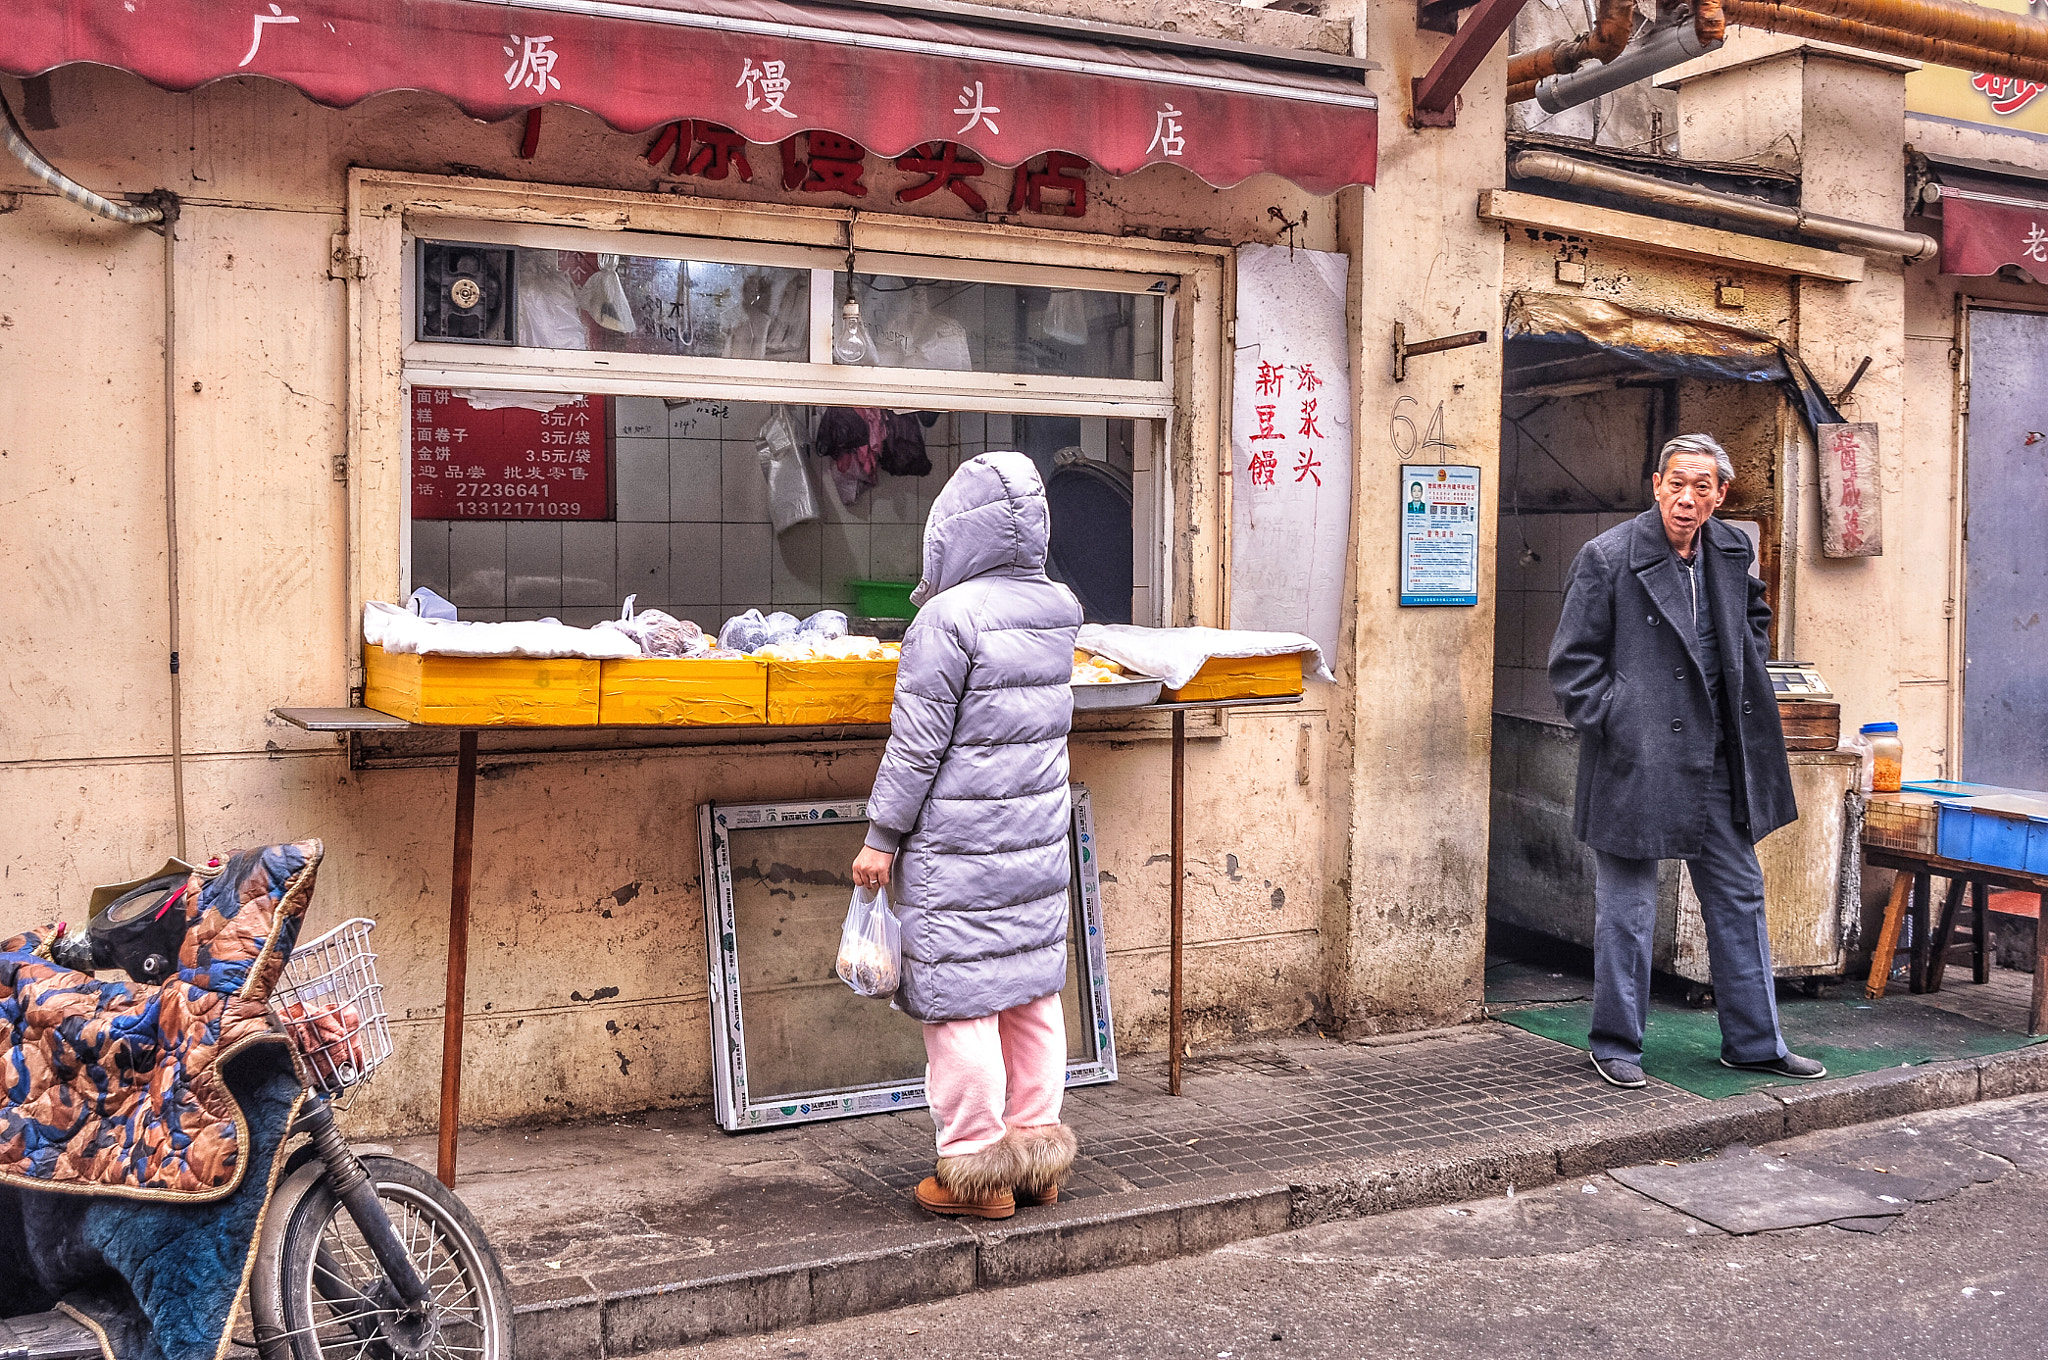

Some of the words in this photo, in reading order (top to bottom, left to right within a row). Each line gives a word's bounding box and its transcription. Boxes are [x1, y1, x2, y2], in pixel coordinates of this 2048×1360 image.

[240, 3, 1186, 156] 广源馒头店
[412, 389, 450, 405] 面饼
[412, 408, 433, 423] 糕
[540, 412, 590, 427] 3元/个
[1249, 397, 1324, 443] 豆浆
[412, 427, 469, 443] 面卷子
[541, 430, 591, 446] 3元/袋
[1389, 395, 1457, 464] 64
[412, 446, 451, 461] 金饼
[526, 449, 591, 464] 3.5元/袋
[504, 466, 589, 480] 批发零售
[1247, 447, 1322, 490] 馒头
[456, 483, 550, 498] 27236641
[456, 502, 581, 516] 13312171039
